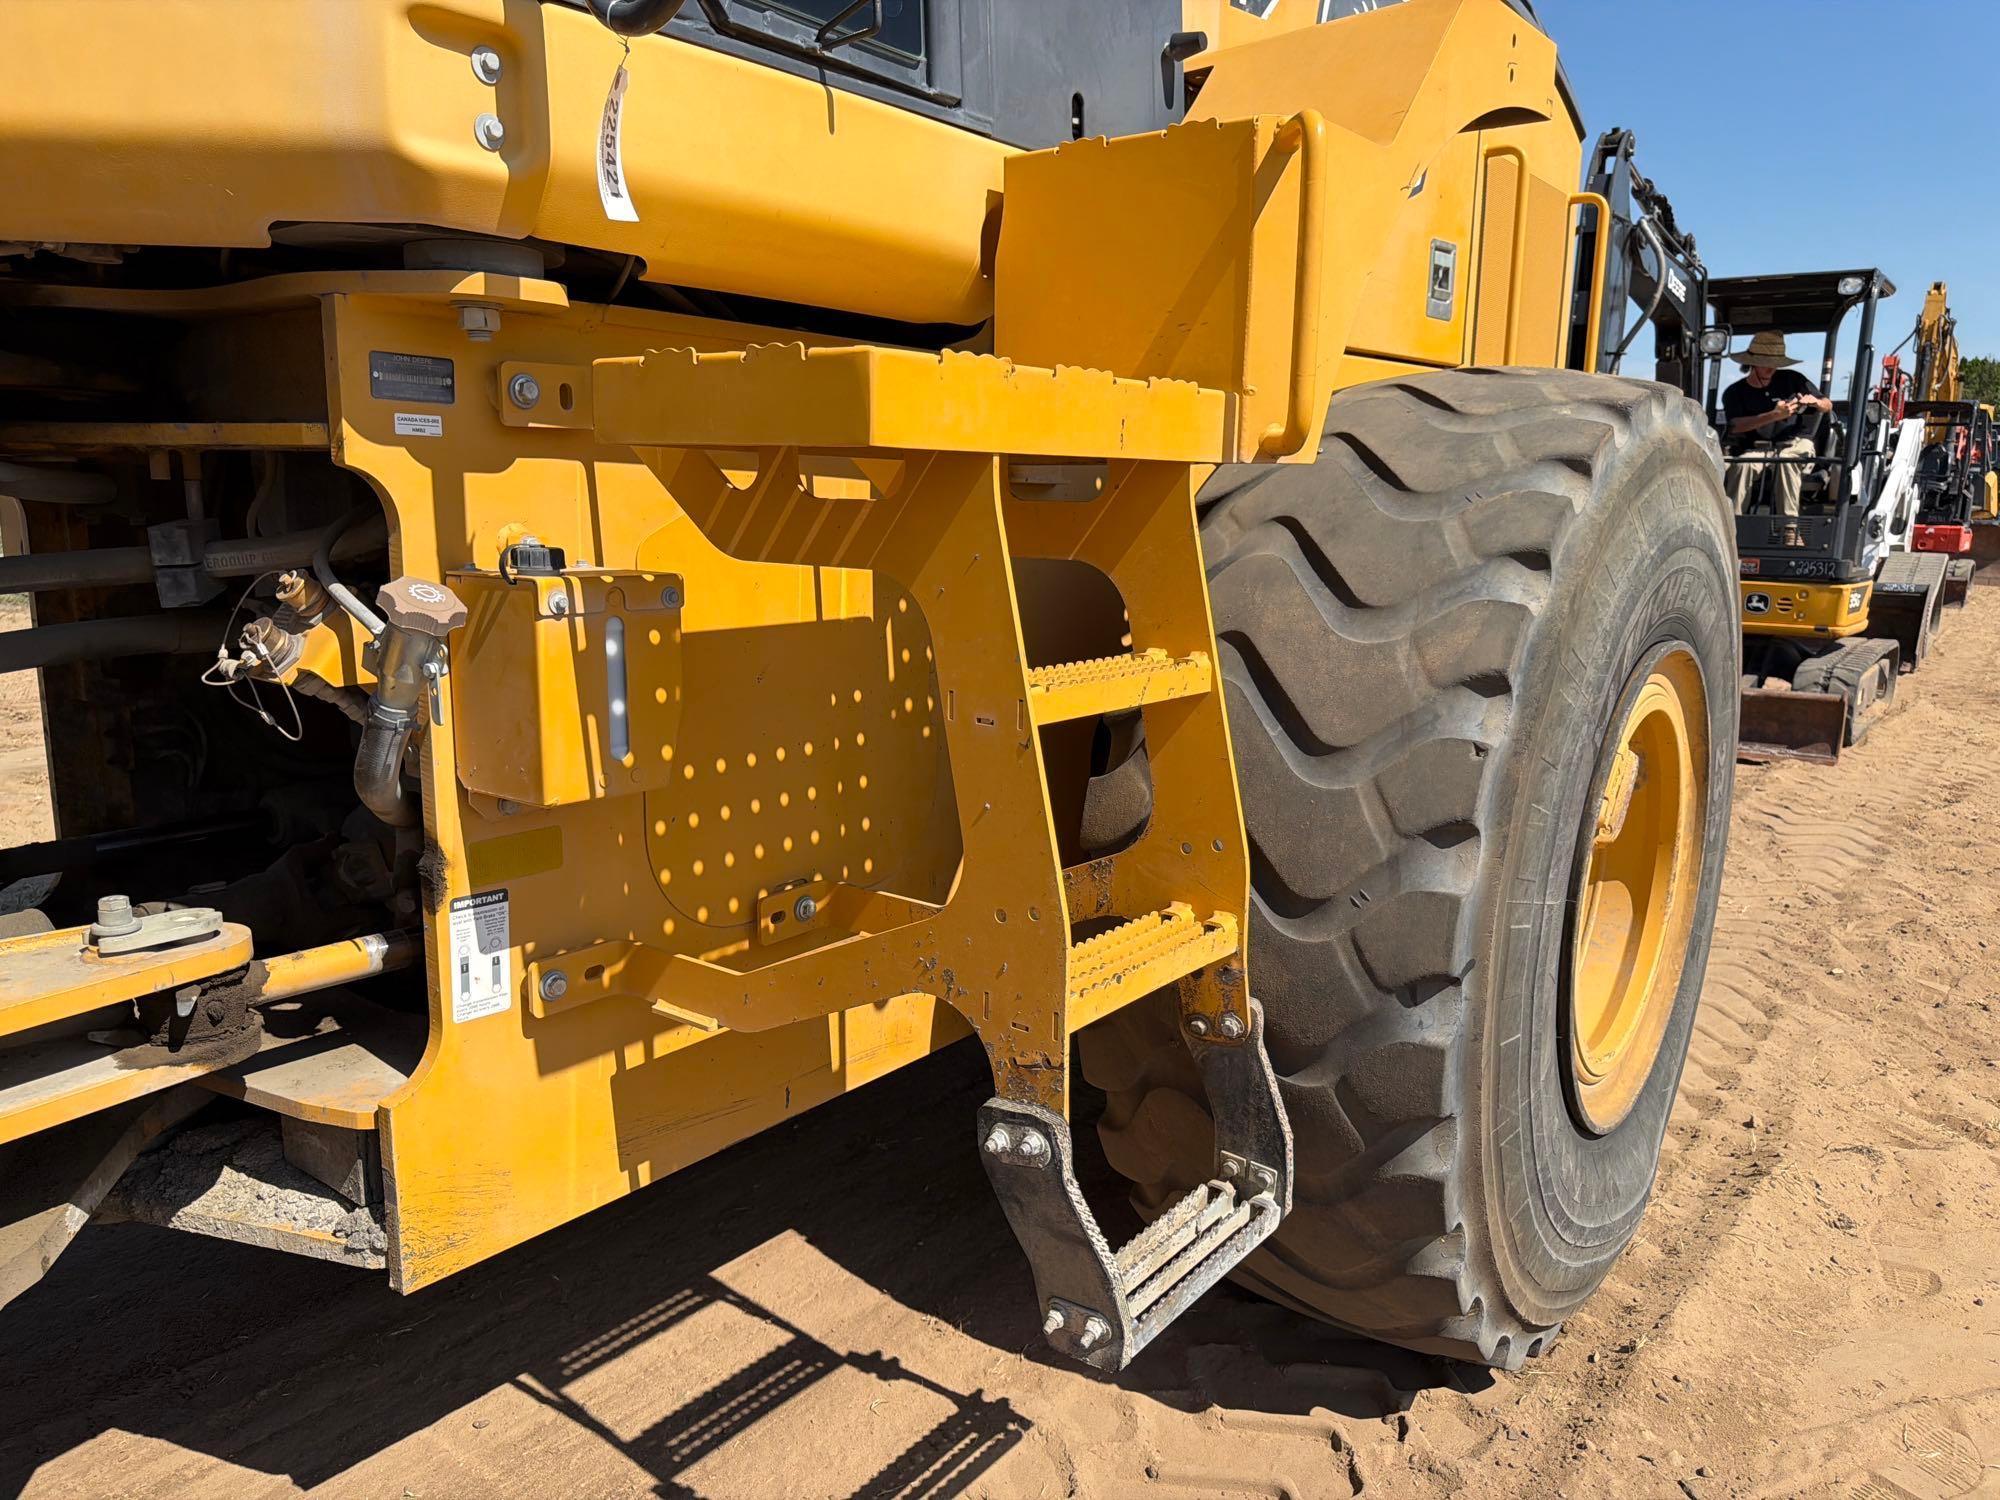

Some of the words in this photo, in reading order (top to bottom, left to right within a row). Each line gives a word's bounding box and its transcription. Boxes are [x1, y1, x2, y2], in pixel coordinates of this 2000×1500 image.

[1667, 268, 1687, 303] DEERE
[412, 356, 433, 365] DEERE
[1796, 560, 1837, 578] 225312
[453, 893, 504, 910] IMPORTANT
